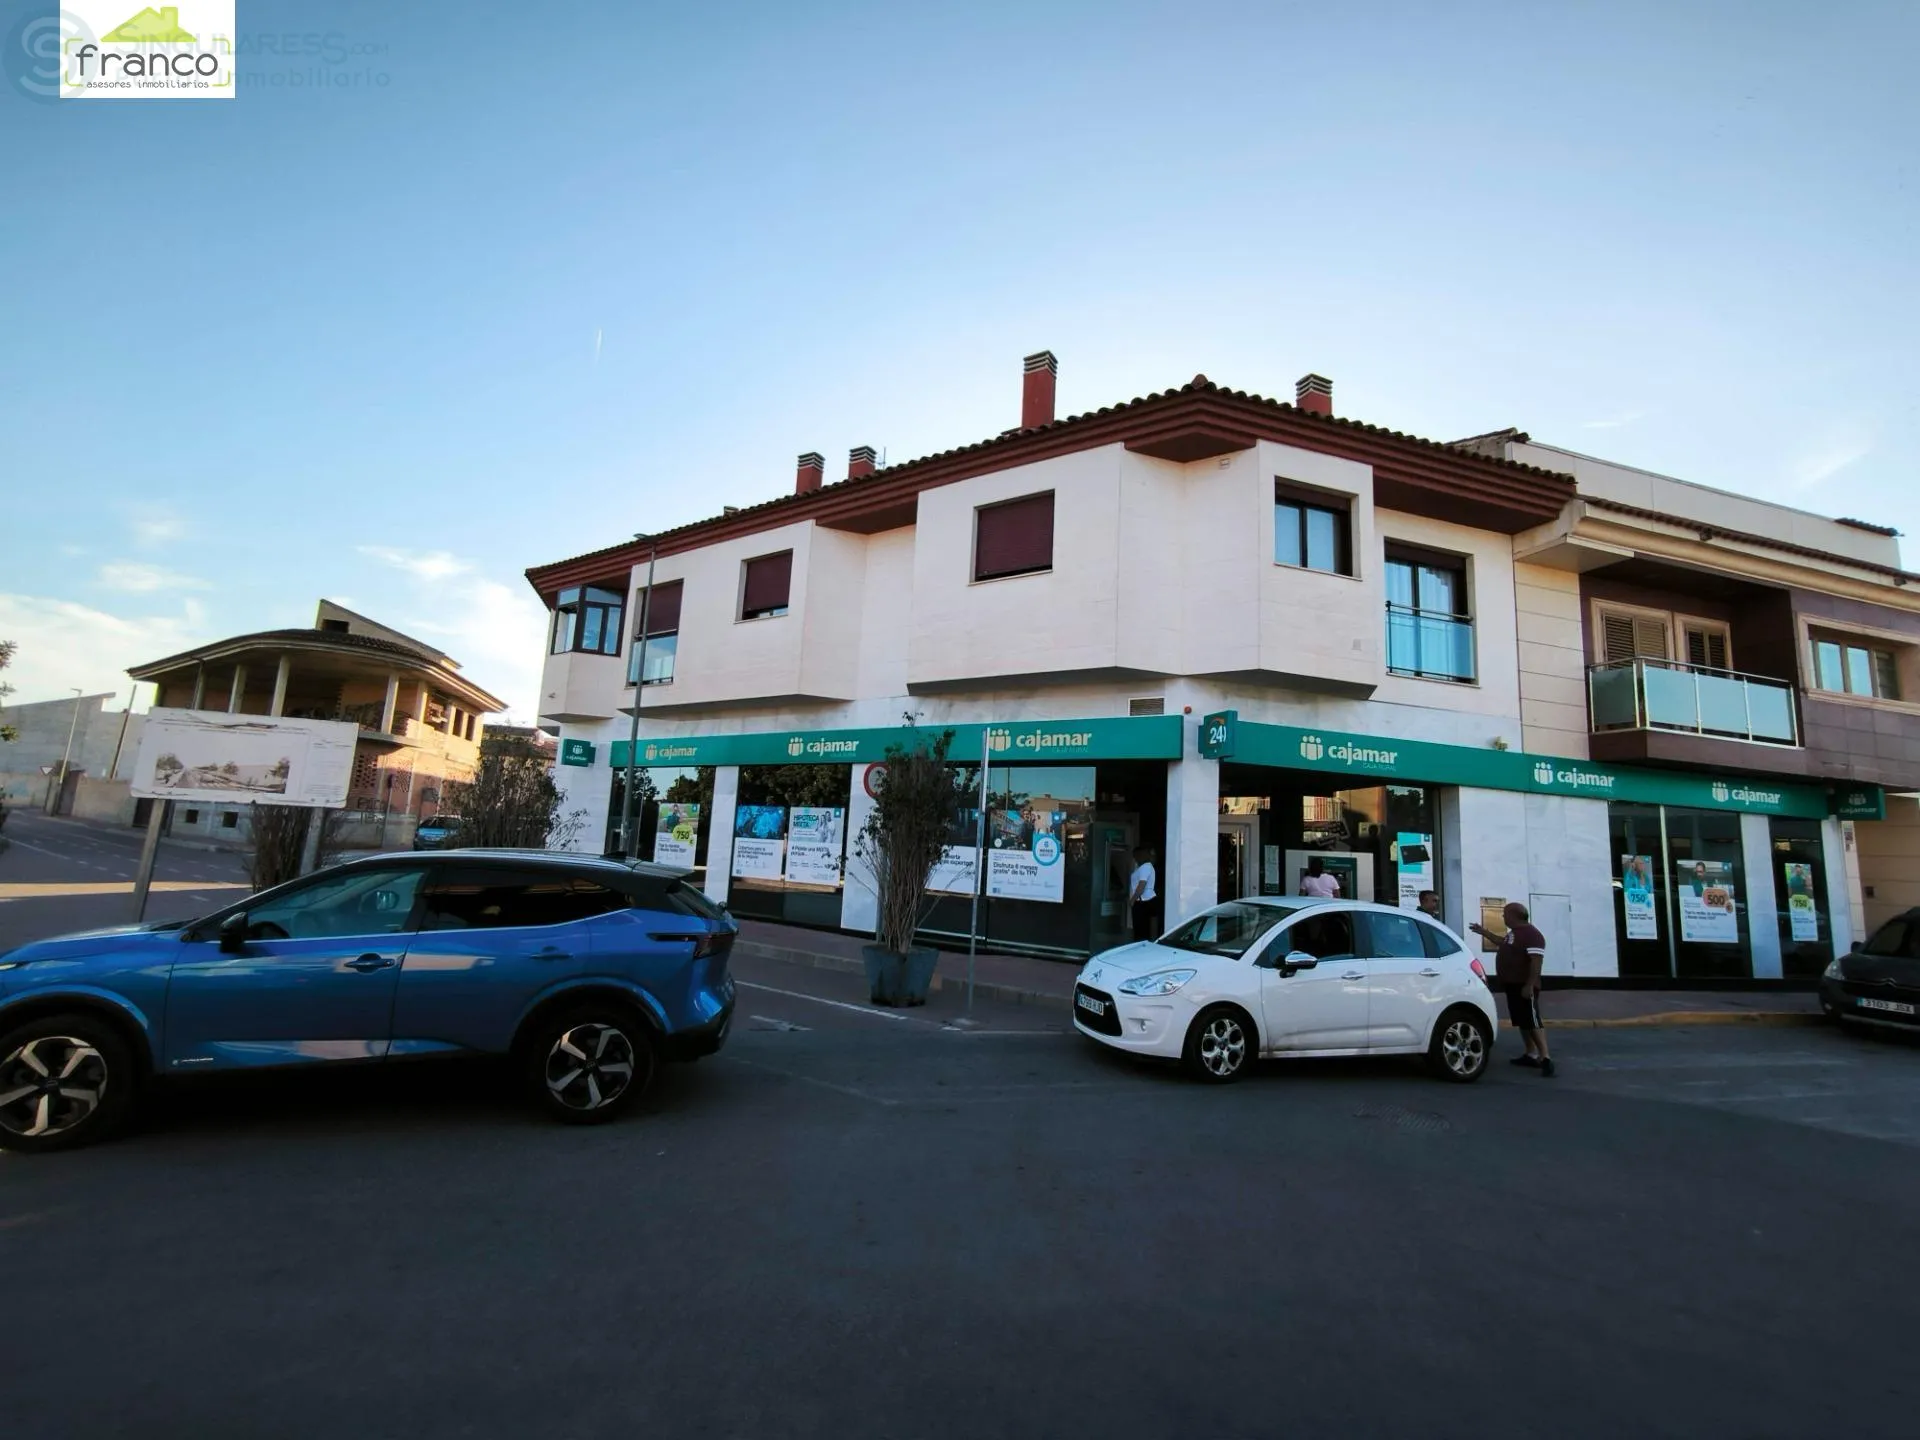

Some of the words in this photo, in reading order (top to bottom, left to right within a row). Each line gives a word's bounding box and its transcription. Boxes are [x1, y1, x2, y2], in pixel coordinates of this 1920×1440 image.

[806, 737, 859, 756] cajamar
[1016, 729, 1092, 752] cajamar
[659, 744, 698, 760] cajamar
[1328, 741, 1397, 765] cajamar
[1557, 767, 1615, 788] cajamar
[1731, 786, 1781, 805] cajamar
[676, 830, 690, 840] 750
[1630, 893, 1646, 903] 750
[1707, 894, 1725, 905] 500
